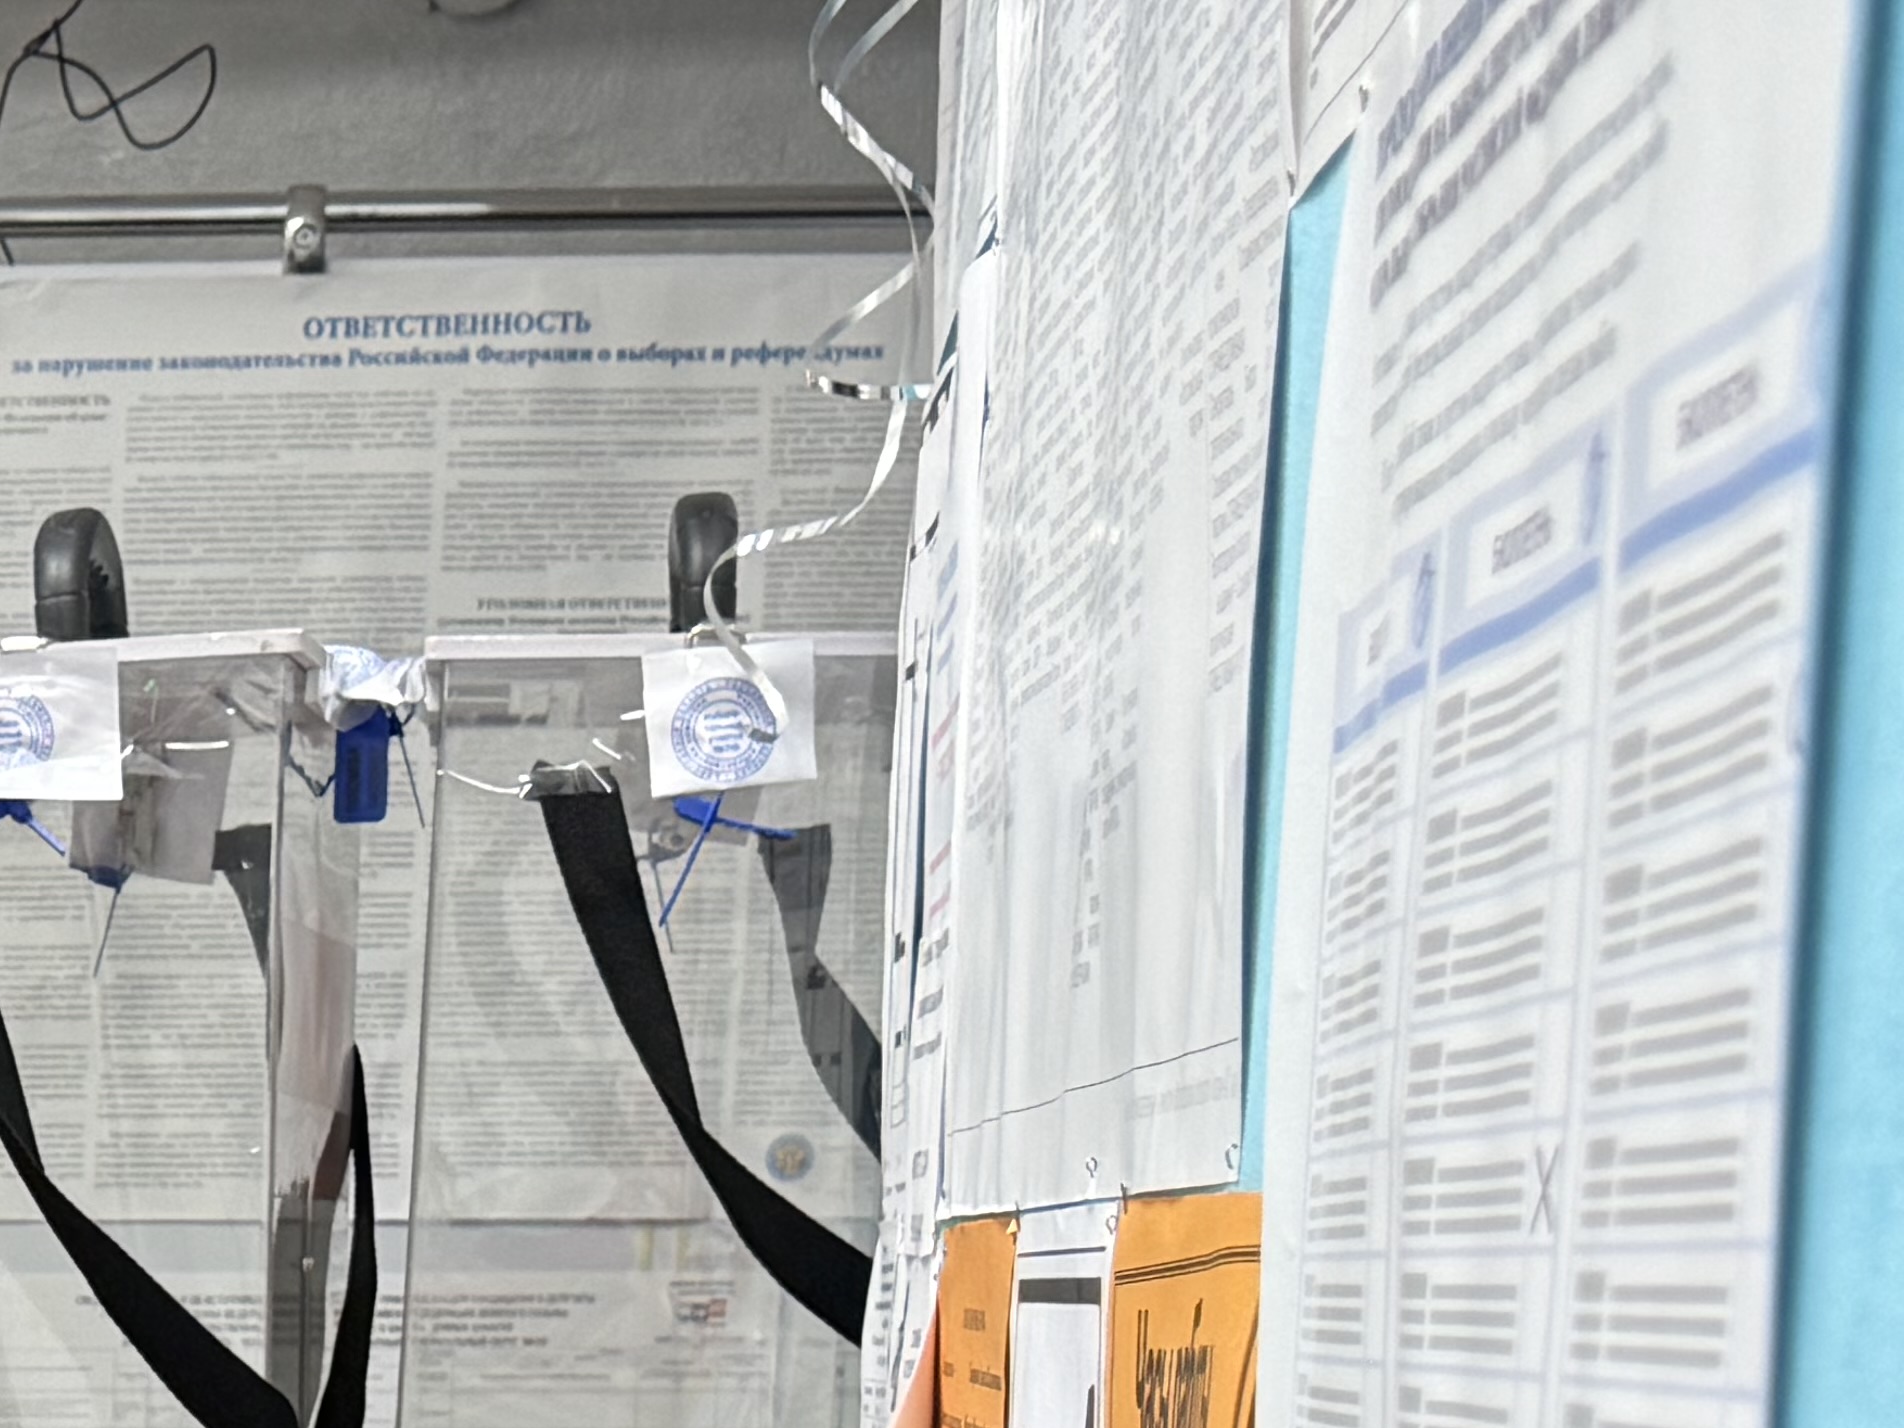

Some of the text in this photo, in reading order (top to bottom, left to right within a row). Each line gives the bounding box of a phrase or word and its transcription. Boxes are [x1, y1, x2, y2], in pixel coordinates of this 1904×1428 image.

[303, 311, 592, 340] ОТВЕТСТВЕННОСТЬ
[38, 355, 153, 378] нарушение
[158, 351, 343, 373] законодательства
[347, 347, 470, 368] Российской
[476, 346, 592, 369] Федерации
[598, 349, 610, 363] о
[616, 340, 707, 368] выборах
[711, 348, 725, 363] и
